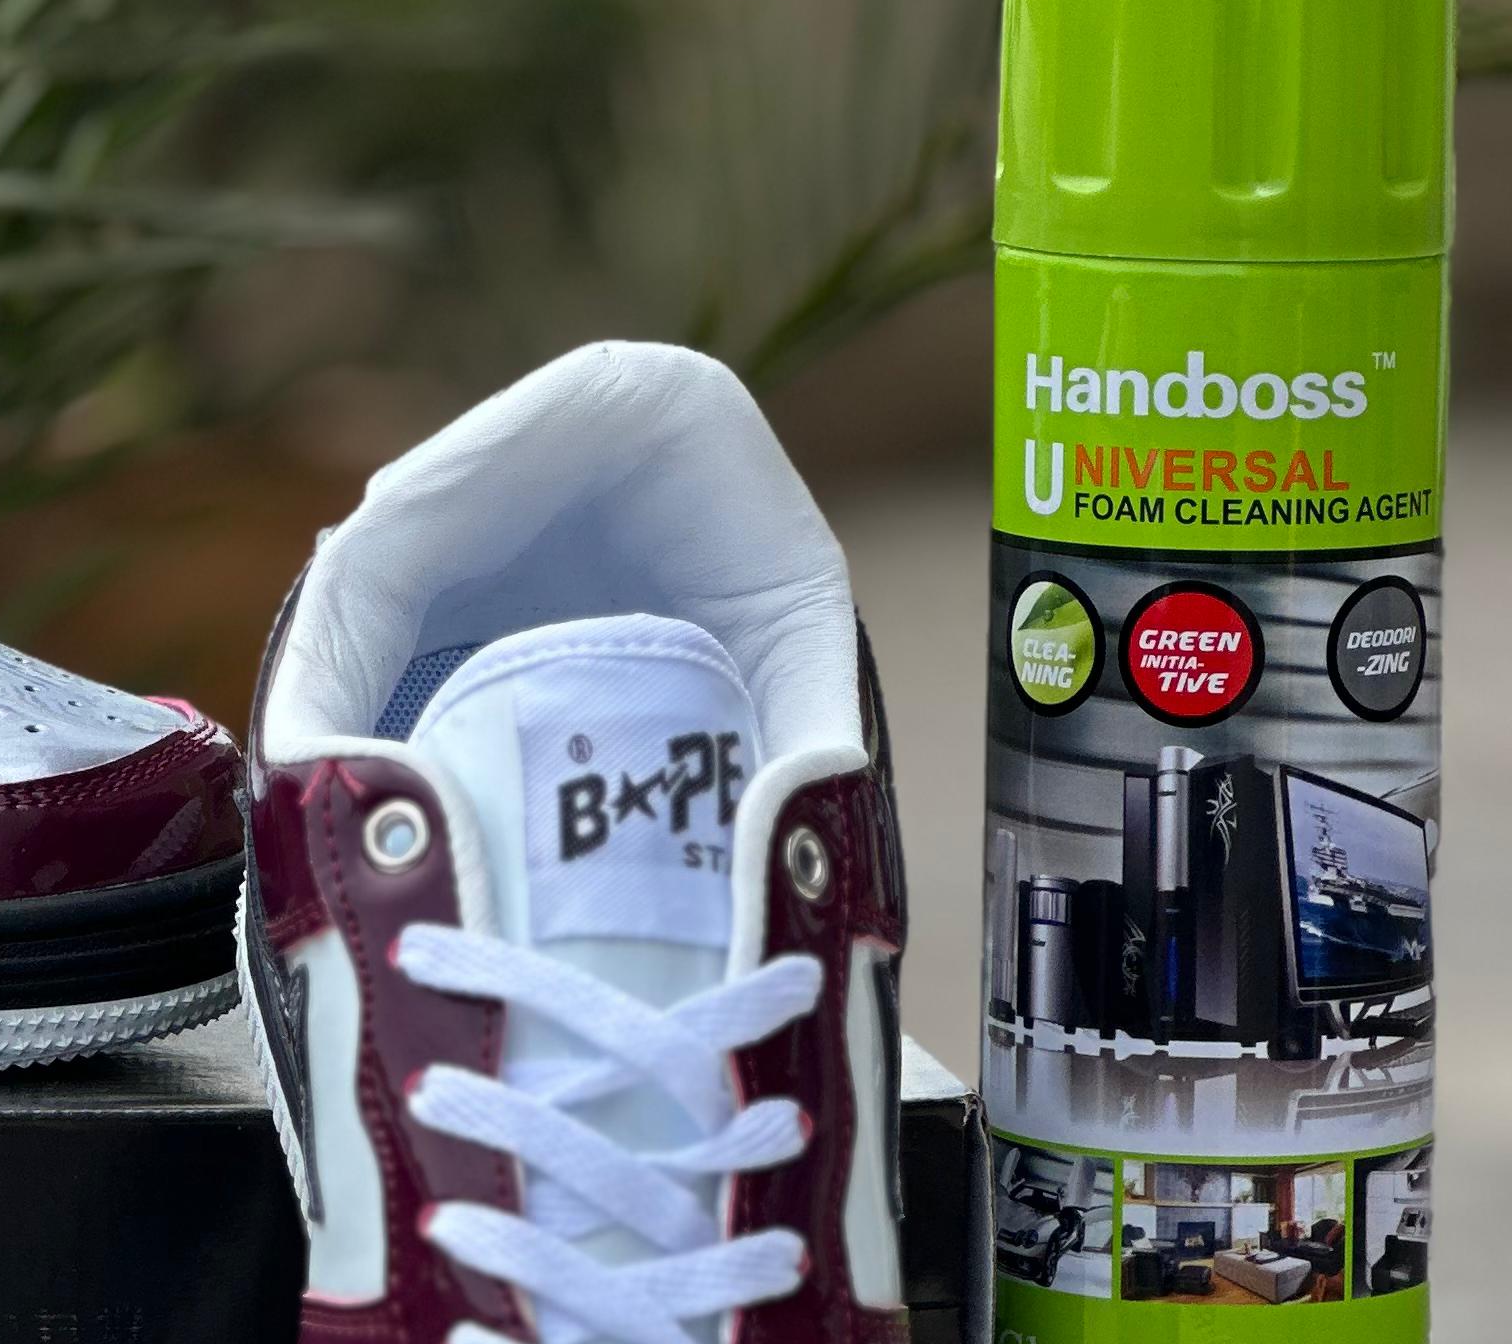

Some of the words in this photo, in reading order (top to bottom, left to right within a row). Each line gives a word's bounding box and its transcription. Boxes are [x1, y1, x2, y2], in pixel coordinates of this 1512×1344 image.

[1025, 350, 1368, 419] Handboss
[1074, 492, 1164, 523] FOAM
[1174, 496, 1349, 525] CLEANING
[1356, 488, 1433, 523] AGENT
[1138, 628, 1242, 652] GREEN
[1346, 625, 1416, 650] DEODORI
[1140, 654, 1204, 670] INITIA-
[1357, 651, 1410, 676] -ZING
[1021, 664, 1073, 689] NING
[1159, 672, 1229, 694] TIVE
[683, 842, 731, 874] ST
